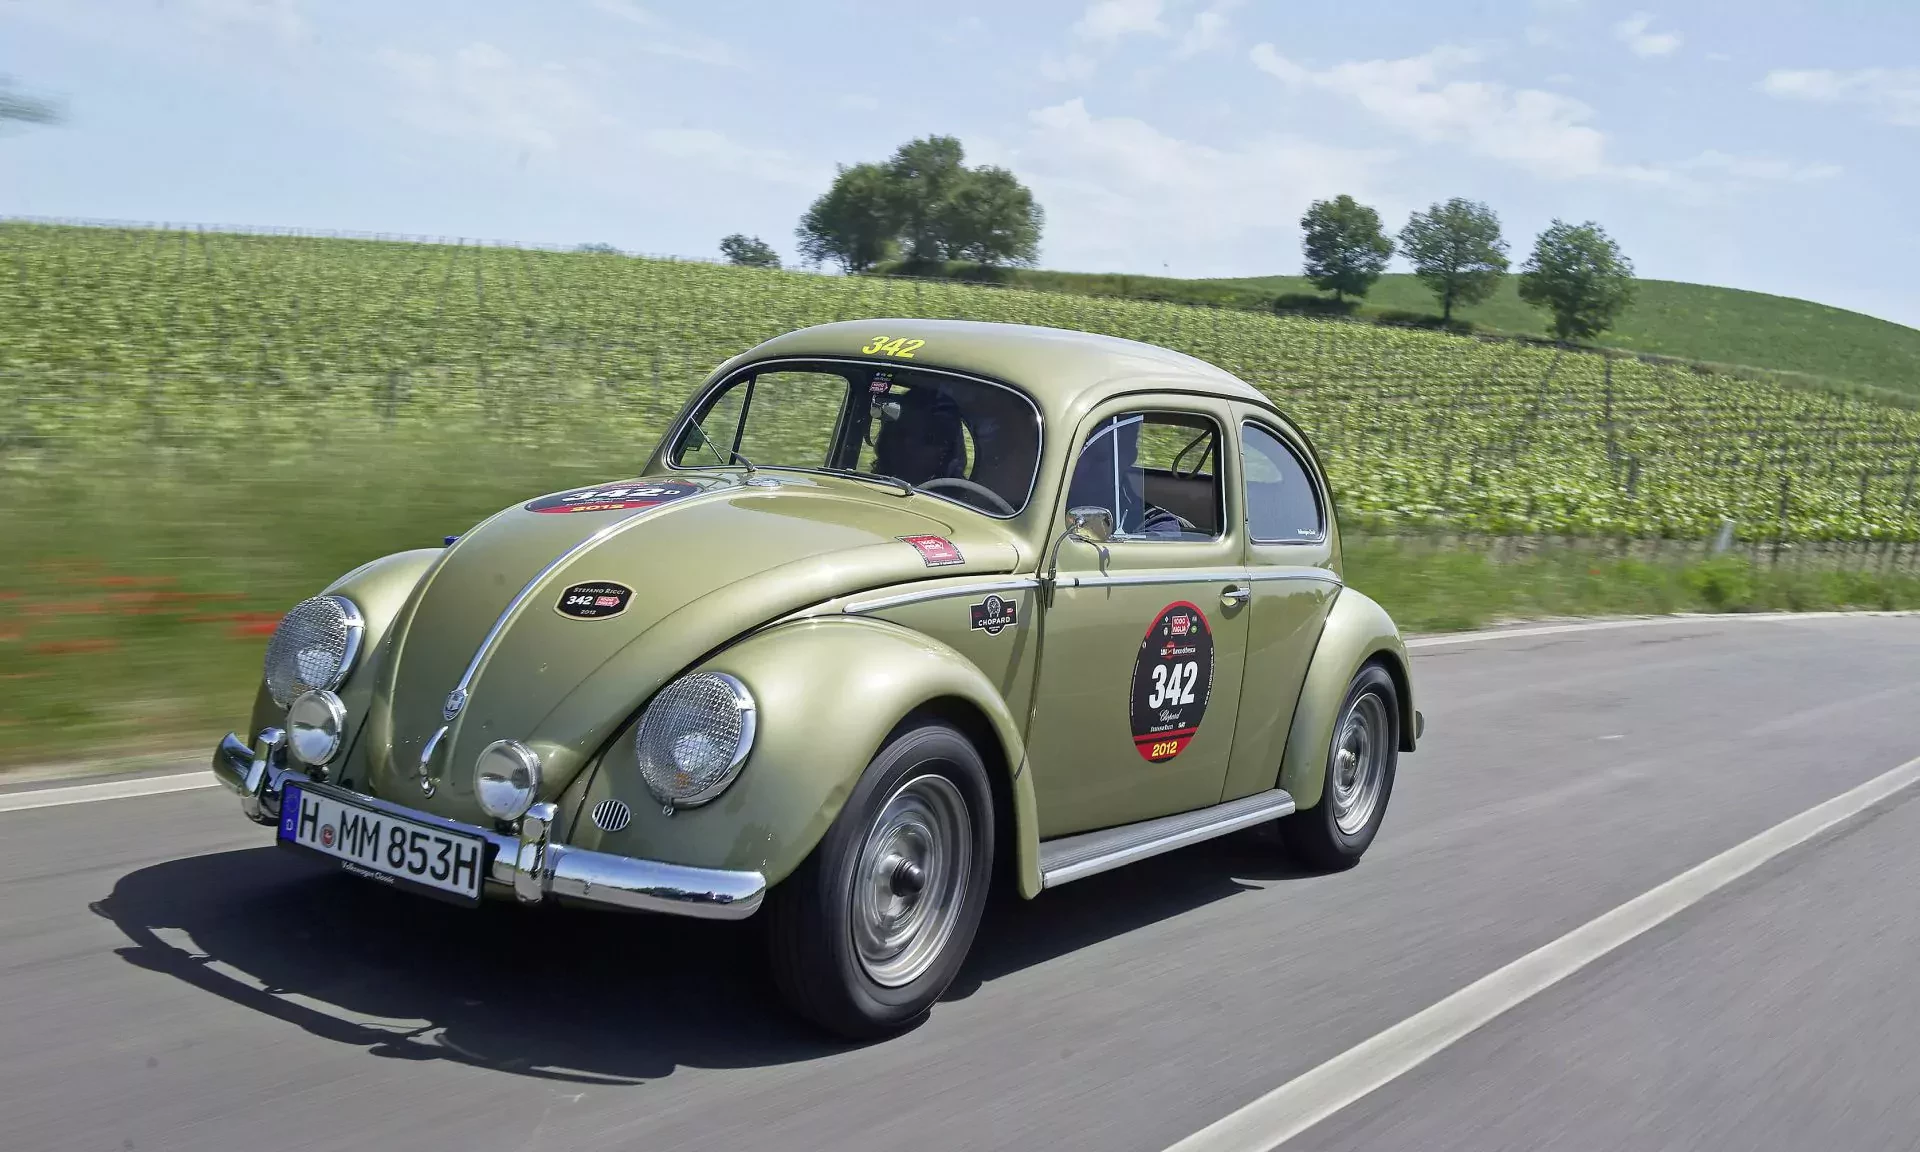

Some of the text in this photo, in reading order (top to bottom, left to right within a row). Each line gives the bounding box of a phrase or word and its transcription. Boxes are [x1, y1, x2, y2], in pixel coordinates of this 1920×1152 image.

[862, 336, 925, 358] 342
[562, 489, 664, 501] 342
[567, 595, 593, 605] 342
[978, 616, 1011, 626] CHOPARD
[1149, 661, 1198, 708] 342
[1152, 741, 1177, 757] 2012
[286, 819, 293, 831] D
[299, 798, 477, 889] H MM 853H
